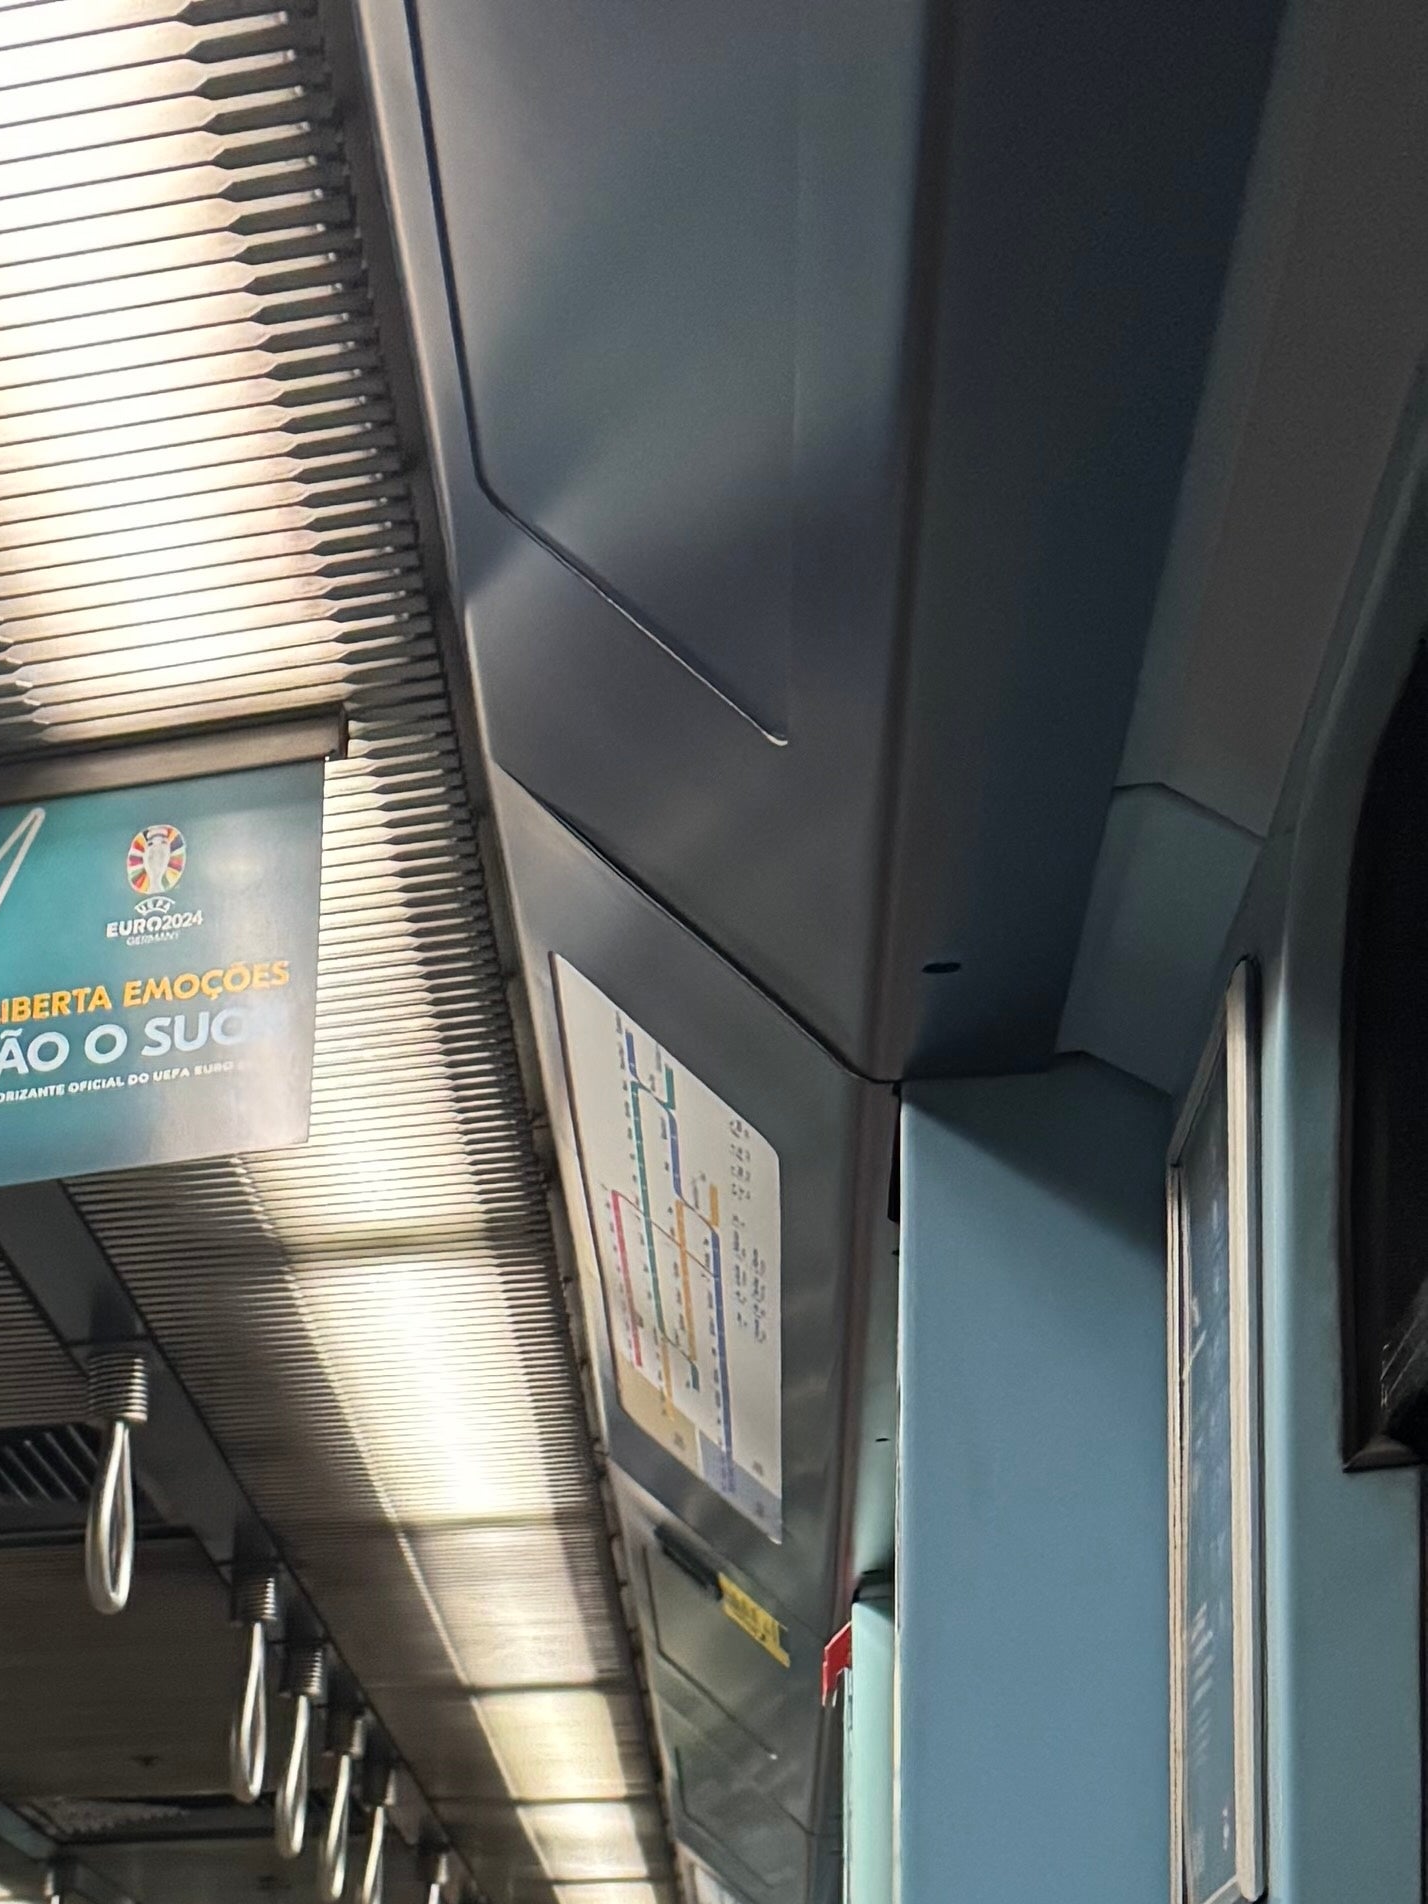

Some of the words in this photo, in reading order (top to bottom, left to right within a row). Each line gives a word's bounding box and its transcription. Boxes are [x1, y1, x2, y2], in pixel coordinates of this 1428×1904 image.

[135, 897, 175, 915] UEFA
[123, 960, 290, 1007] EMOÇÕES
[84, 1023, 128, 1065] O
[68, 1075, 125, 1094] OFICIAL
[127, 1071, 149, 1086] DO
[152, 1067, 191, 1082] UEFA
